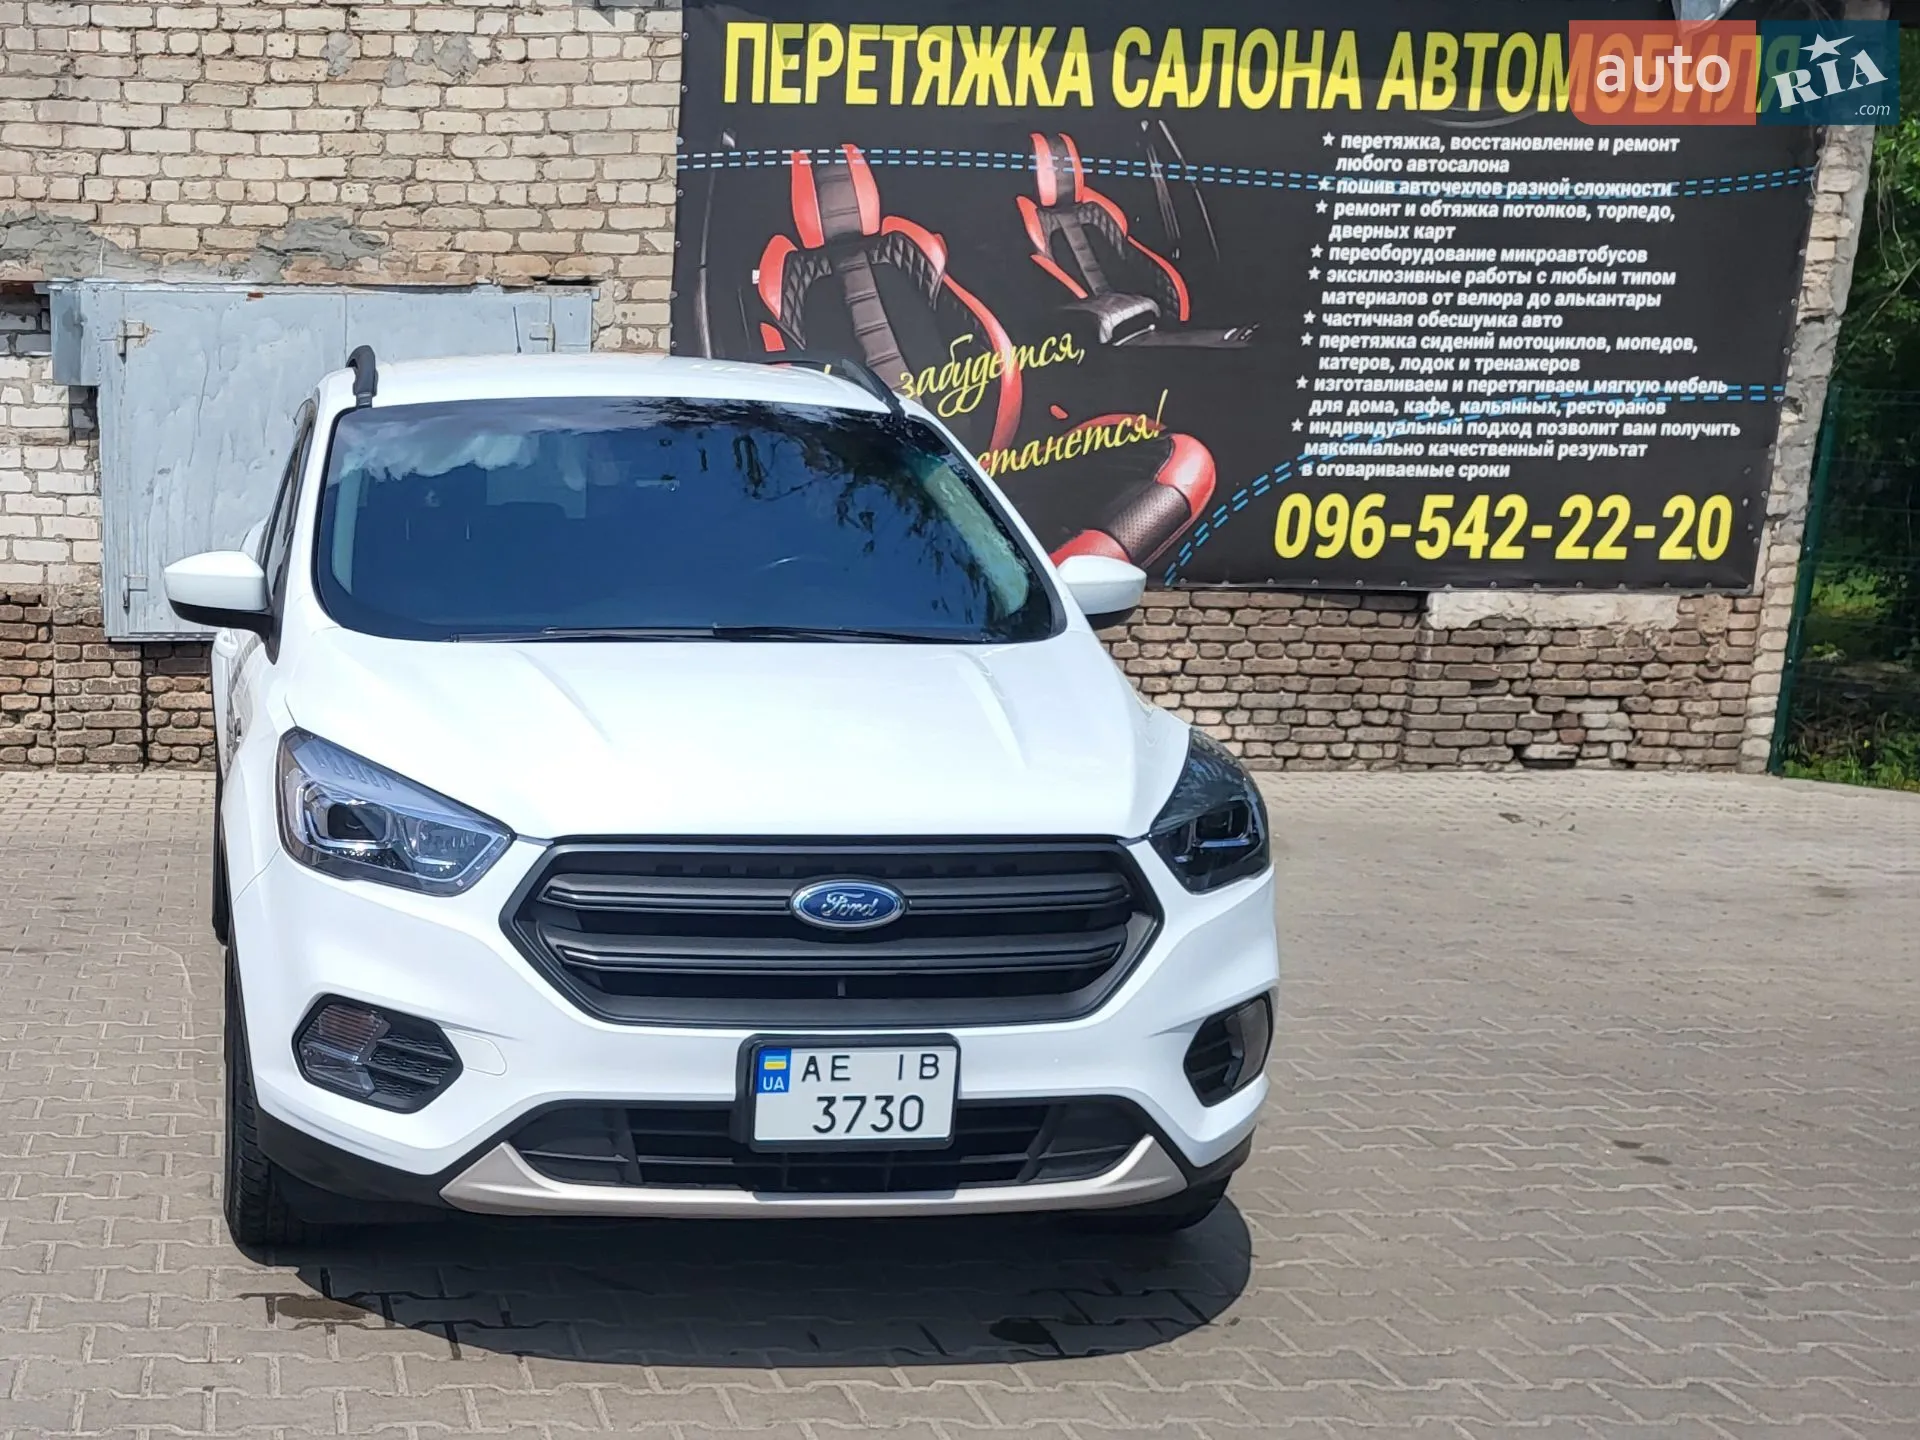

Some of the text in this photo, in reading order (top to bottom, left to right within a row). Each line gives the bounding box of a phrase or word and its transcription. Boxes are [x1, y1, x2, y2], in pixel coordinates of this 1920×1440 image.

[723, 21, 1094, 107] ПЕРЕТЯЖКА
[1111, 26, 1363, 111] САЛОНА
[1341, 135, 1681, 156] перетяжка, восстановление и ремонт
[1335, 153, 1510, 173] любого автосалона
[1336, 177, 1673, 199] пошив авточехлов разной сложности
[1333, 199, 1676, 223] ремонт и обтяжка потолков, торпедо,
[1328, 224, 1457, 243] дверных карт
[1328, 243, 1648, 267] переоборудование микроавтобусов
[1326, 266, 1677, 288] эксклюзивные работы с любым типом
[1321, 291, 1662, 311] материалов от велюра до алькантары
[1321, 309, 1563, 332] частичная обесшумка авто
[1318, 331, 1698, 354] перетяжка сидений мотоциклов, мопедов,
[900, 333, 1086, 417] забудется,
[1318, 356, 1581, 375] катеров, лодок и тренажеров
[1314, 376, 1728, 397] изготавливаем и перетягиваем мягкую мебель
[1308, 396, 1667, 418] для дома, кафе, кальянных, ресторанов
[977, 389, 1169, 478] станется!
[1308, 417, 1741, 440] индивидуальный подход позволит вам получить
[1303, 439, 1649, 461] максимально качественный результат
[1301, 463, 1511, 481] в оговариваемые сроки
[1274, 492, 1733, 561] 096-542-22-20
[821, 891, 880, 917] Ford
[801, 1053, 940, 1082] AE IB
[763, 1077, 785, 1091] UA
[812, 1095, 925, 1134] 3730
